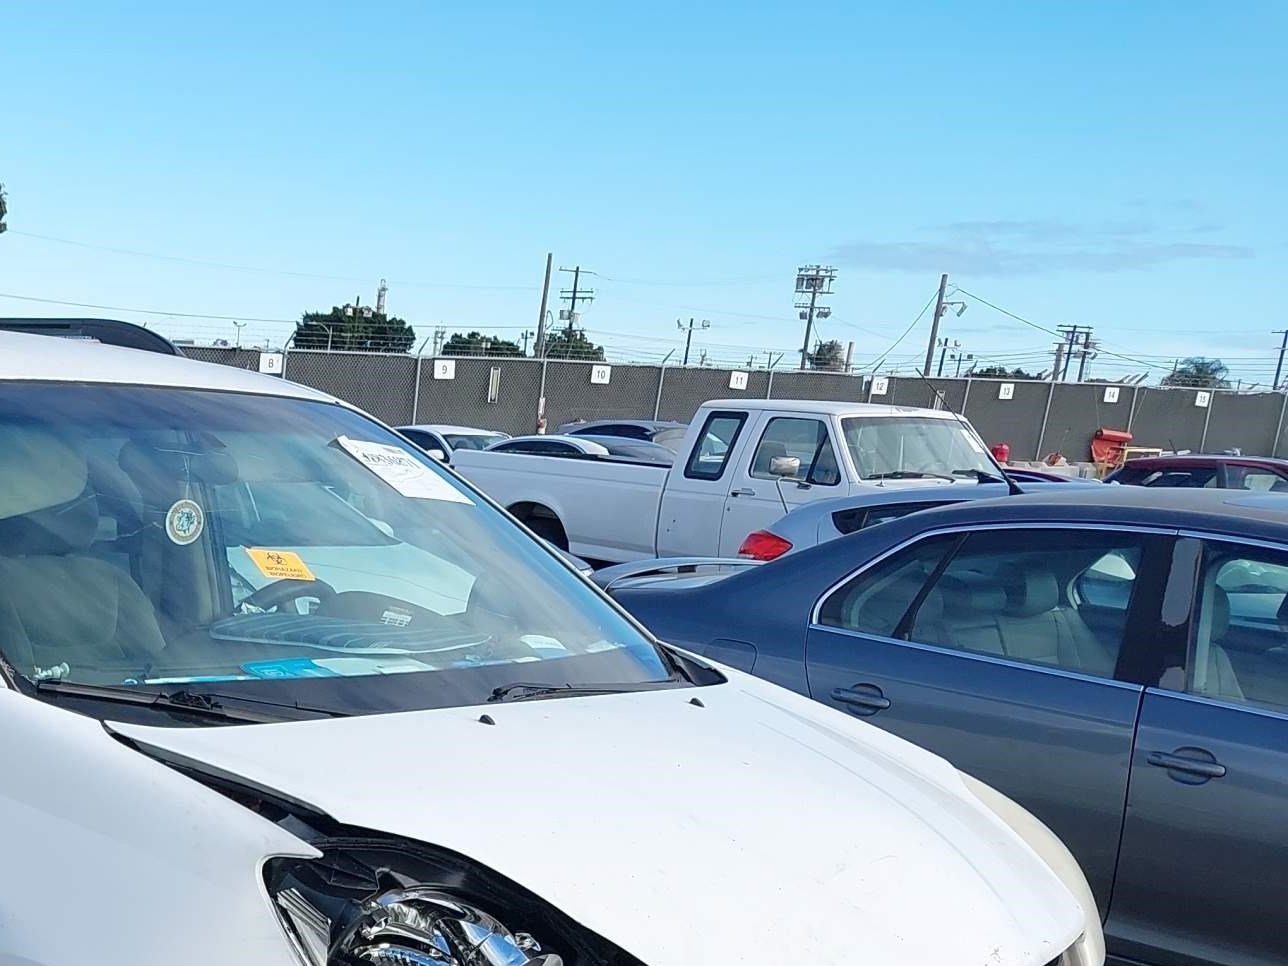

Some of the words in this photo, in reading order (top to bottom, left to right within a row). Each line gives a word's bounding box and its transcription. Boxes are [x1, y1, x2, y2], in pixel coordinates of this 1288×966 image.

[268, 358, 274, 369] 8
[442, 365, 448, 375] 9
[597, 370, 606, 380] 10
[735, 376, 743, 385] 11
[876, 382, 885, 391] 12
